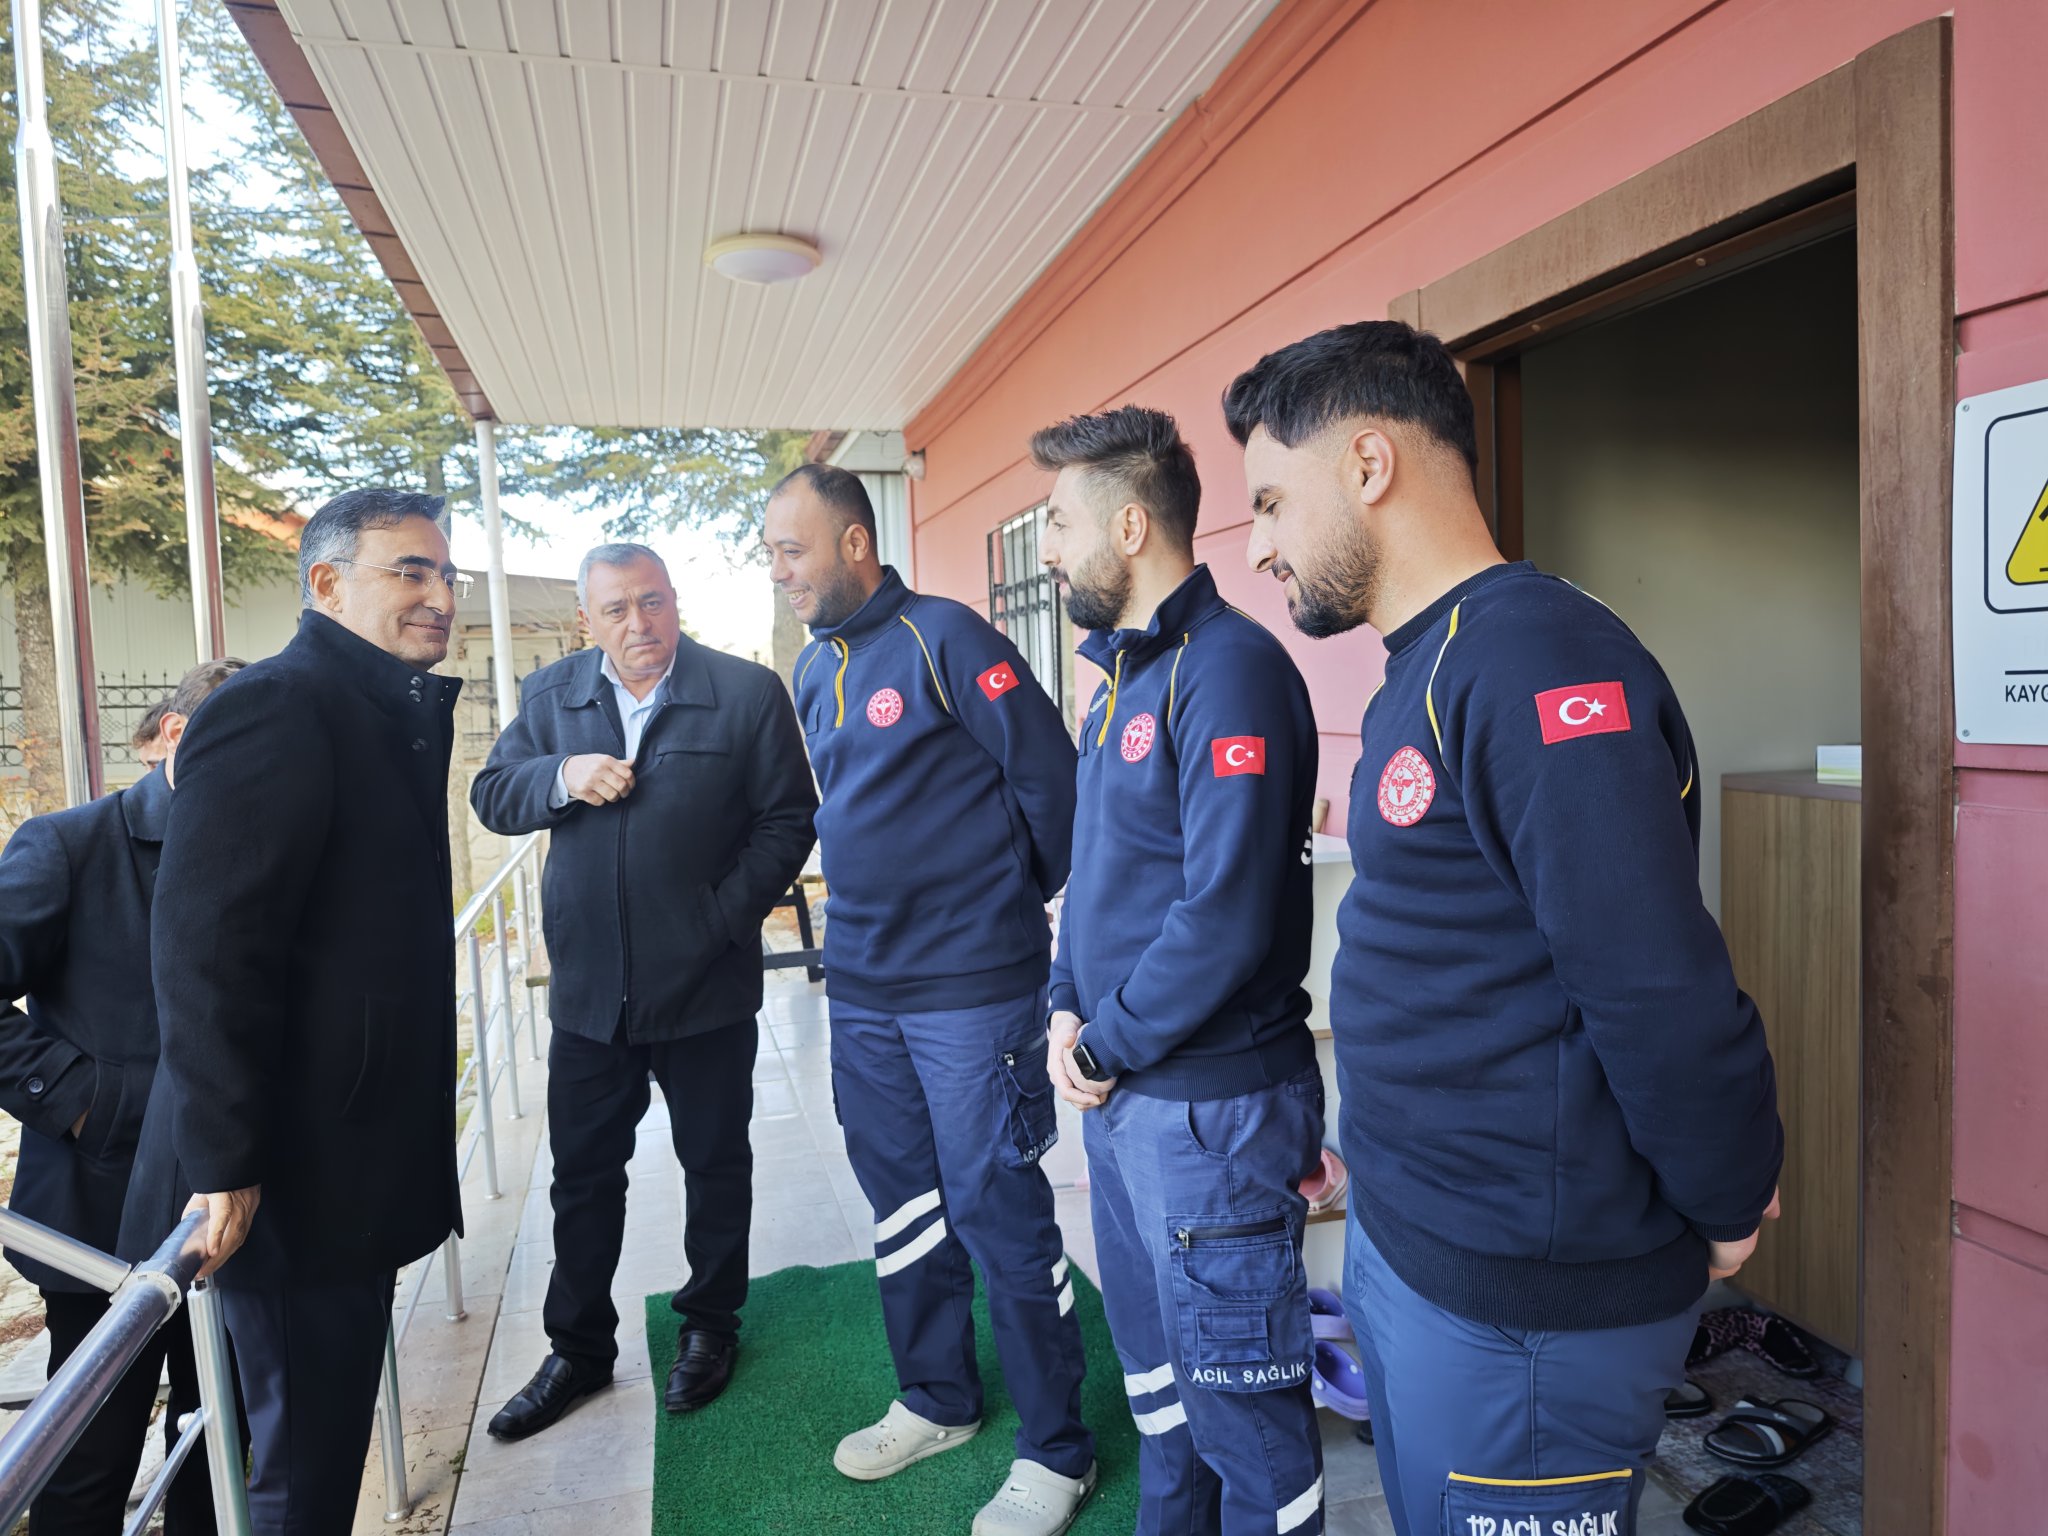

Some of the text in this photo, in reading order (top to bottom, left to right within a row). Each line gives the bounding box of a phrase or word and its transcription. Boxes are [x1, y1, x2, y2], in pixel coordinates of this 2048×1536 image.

[1192, 1361, 1307, 1384] ACİL SAĞLIK
[1466, 1510, 1618, 1536] 112 ACİL SAĞLIK
